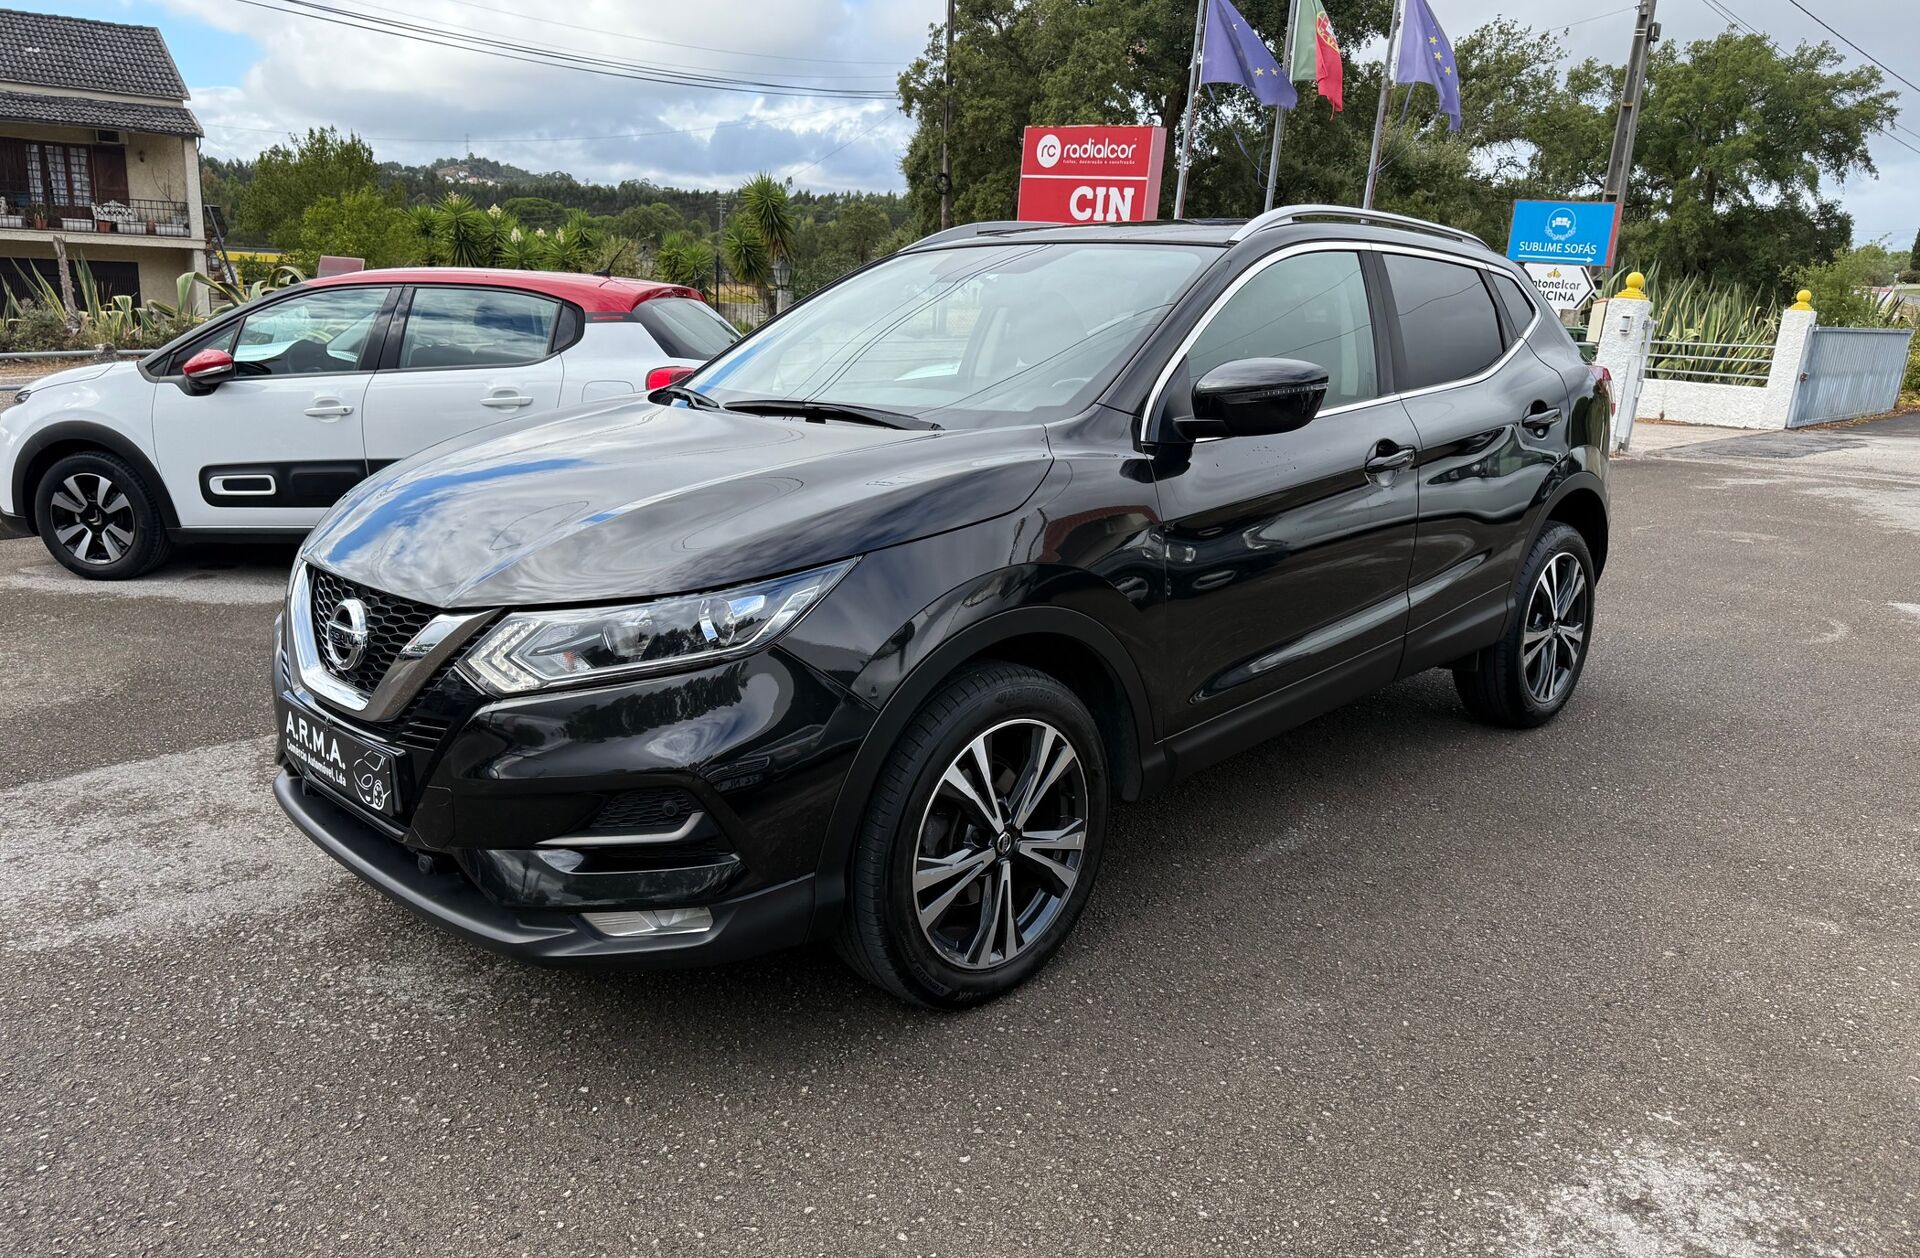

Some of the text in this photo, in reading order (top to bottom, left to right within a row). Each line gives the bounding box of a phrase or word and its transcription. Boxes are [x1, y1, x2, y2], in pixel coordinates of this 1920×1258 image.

[1063, 137, 1136, 159] radialcor
[1069, 185, 1135, 222] CIN
[1519, 241, 1597, 255] SUBLIME SOFÁS
[1532, 279, 1581, 290] ntonelcar
[286, 711, 346, 770] A.R.M.A.
